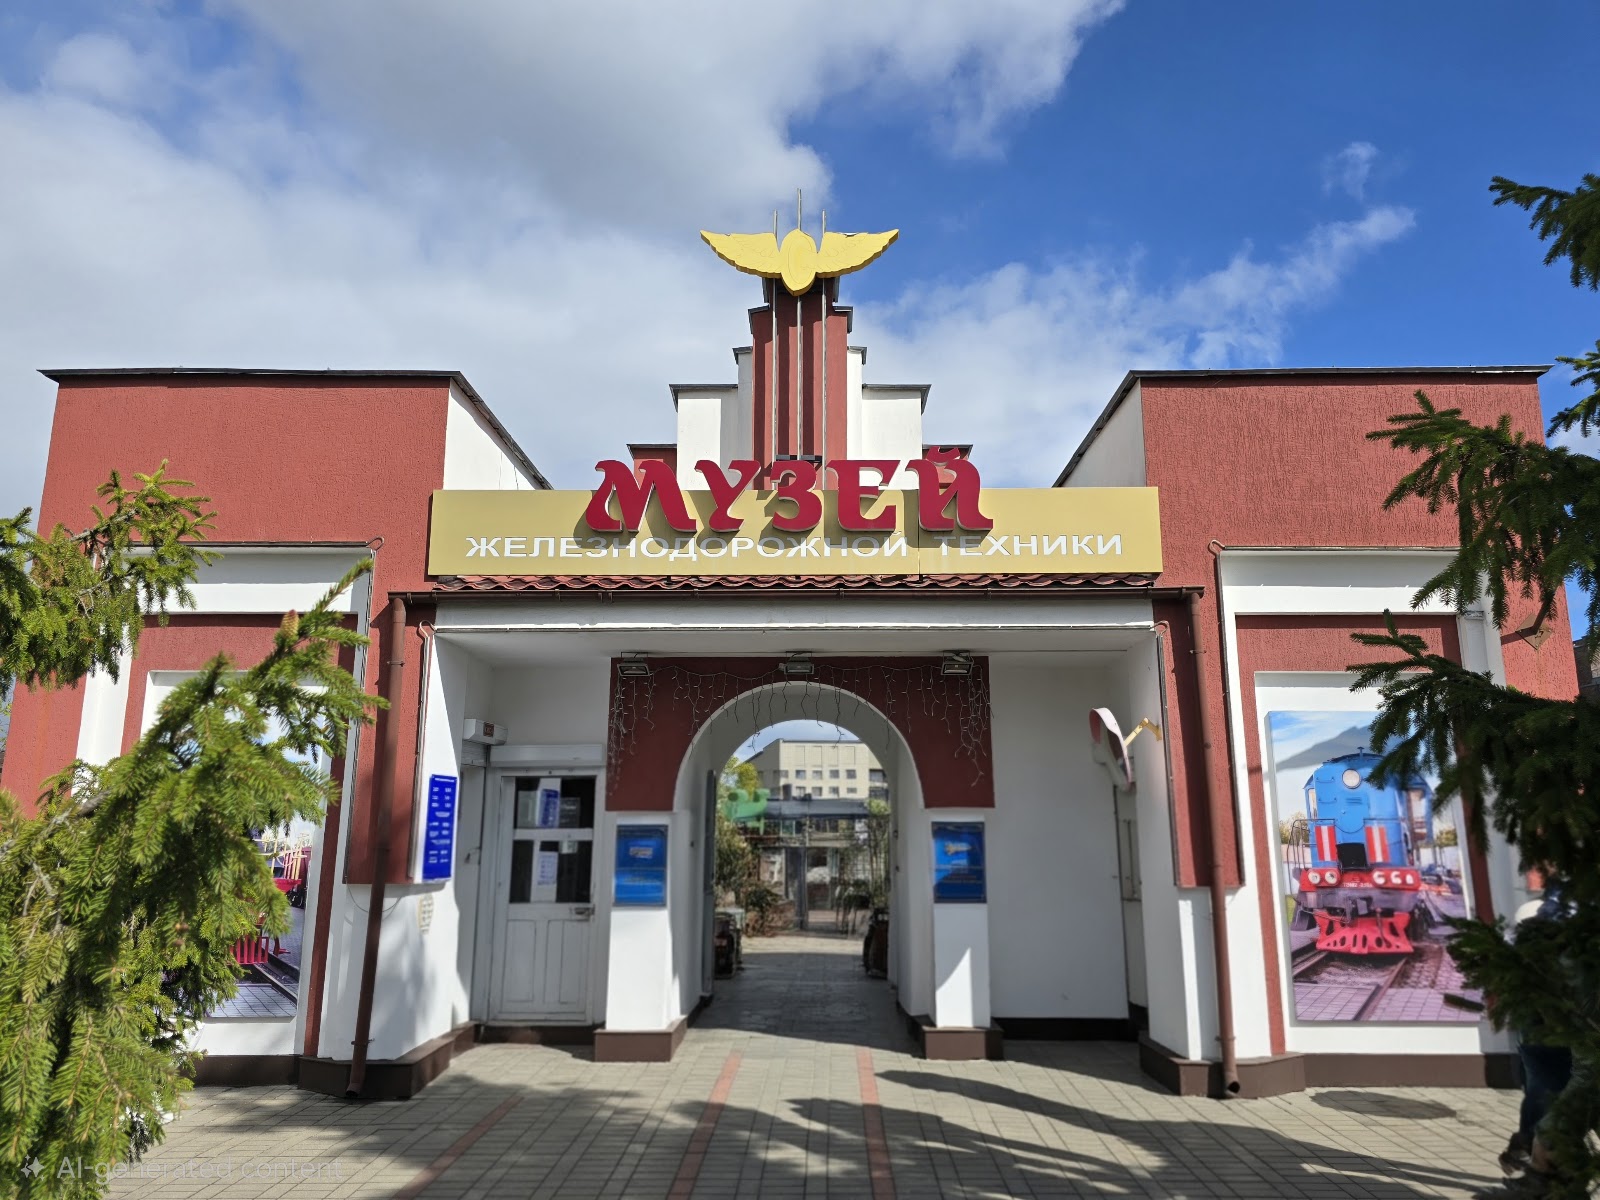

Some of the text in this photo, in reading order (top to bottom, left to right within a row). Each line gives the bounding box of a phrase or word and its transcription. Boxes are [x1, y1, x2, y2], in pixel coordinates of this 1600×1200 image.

[586, 446, 994, 532] МУЗЕЙ
[465, 532, 1122, 561] ЖЕЛЕЗНОДОРОЖНОЙ ТЕХНИКИ
